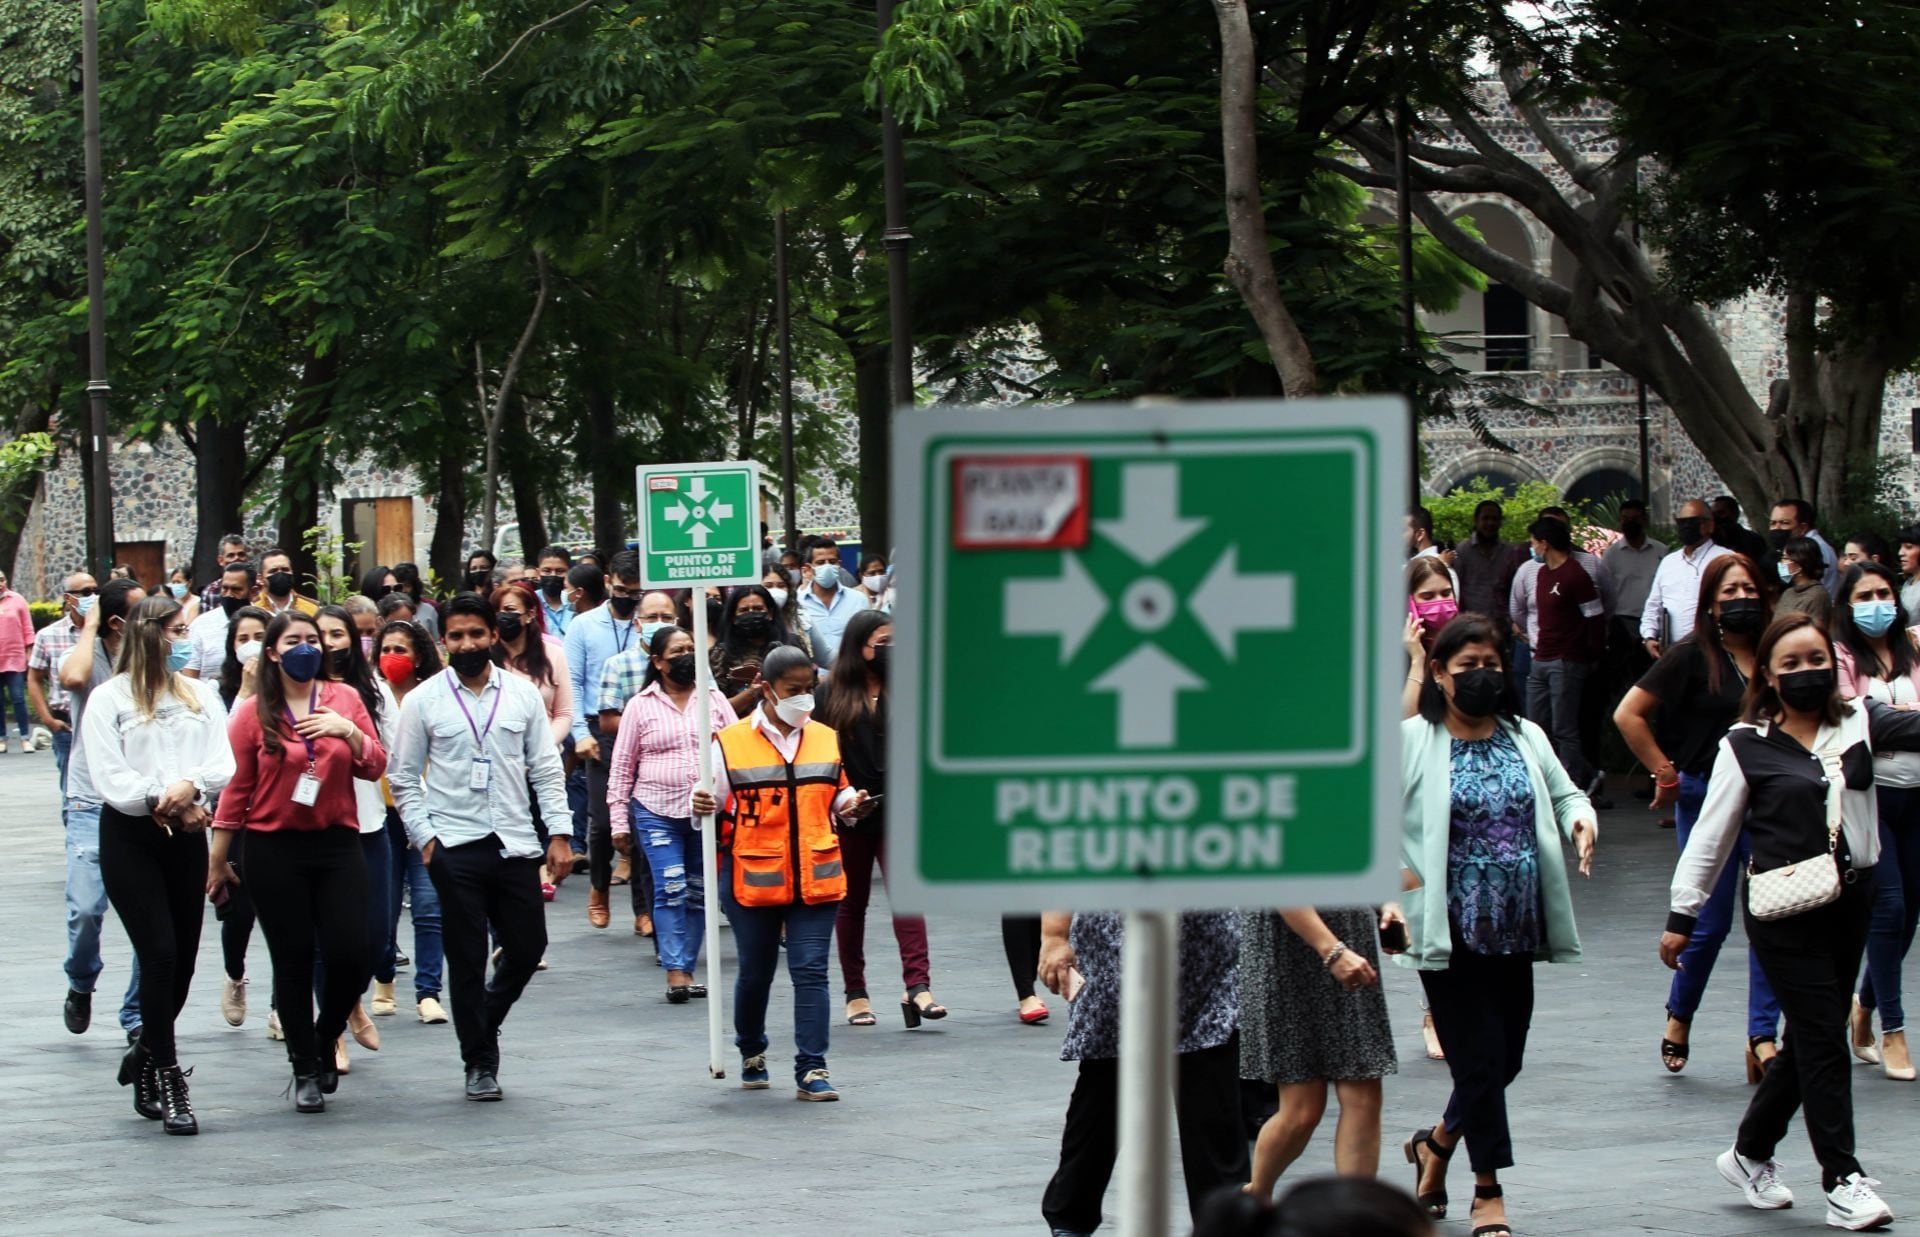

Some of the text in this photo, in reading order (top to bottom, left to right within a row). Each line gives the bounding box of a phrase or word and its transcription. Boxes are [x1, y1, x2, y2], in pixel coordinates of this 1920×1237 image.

[665, 553, 735, 566] PUNTO DE
[668, 565, 733, 578] REUNION
[997, 774, 1297, 822] PUNTO DE
[1009, 825, 1282, 872] REUNION
